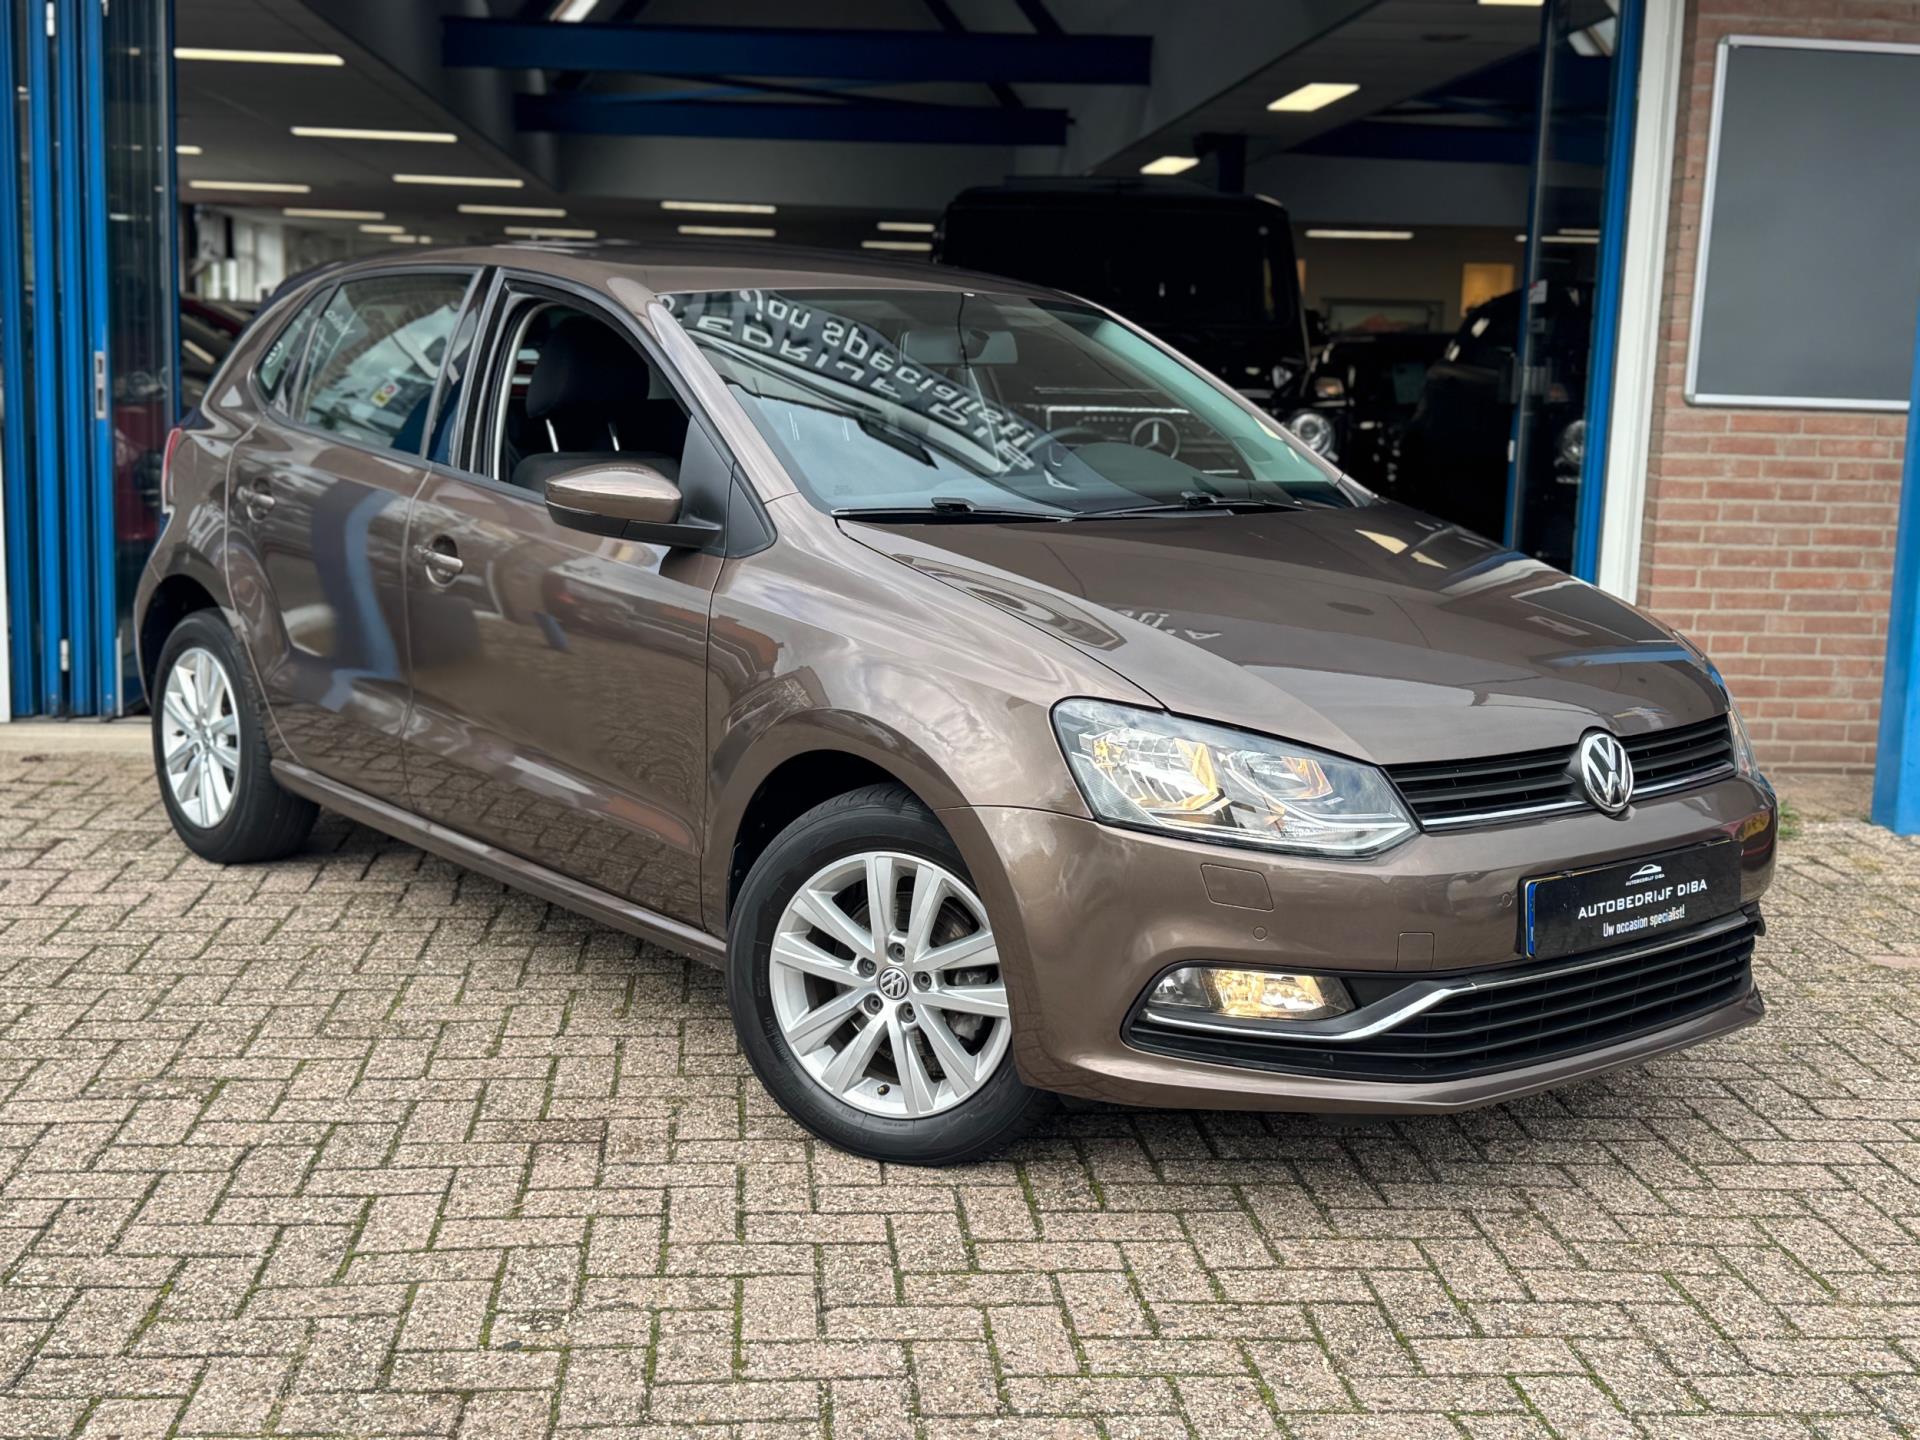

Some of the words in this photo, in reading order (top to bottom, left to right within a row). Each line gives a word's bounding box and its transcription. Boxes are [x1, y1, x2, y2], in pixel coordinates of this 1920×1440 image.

[1578, 887, 1674, 919] AUTOBEDRIJF
[1677, 879, 1708, 897] DIBA
[1602, 922, 1616, 938] Uw
[1616, 916, 1649, 934] occasion
[1649, 904, 1685, 928] specialist!
